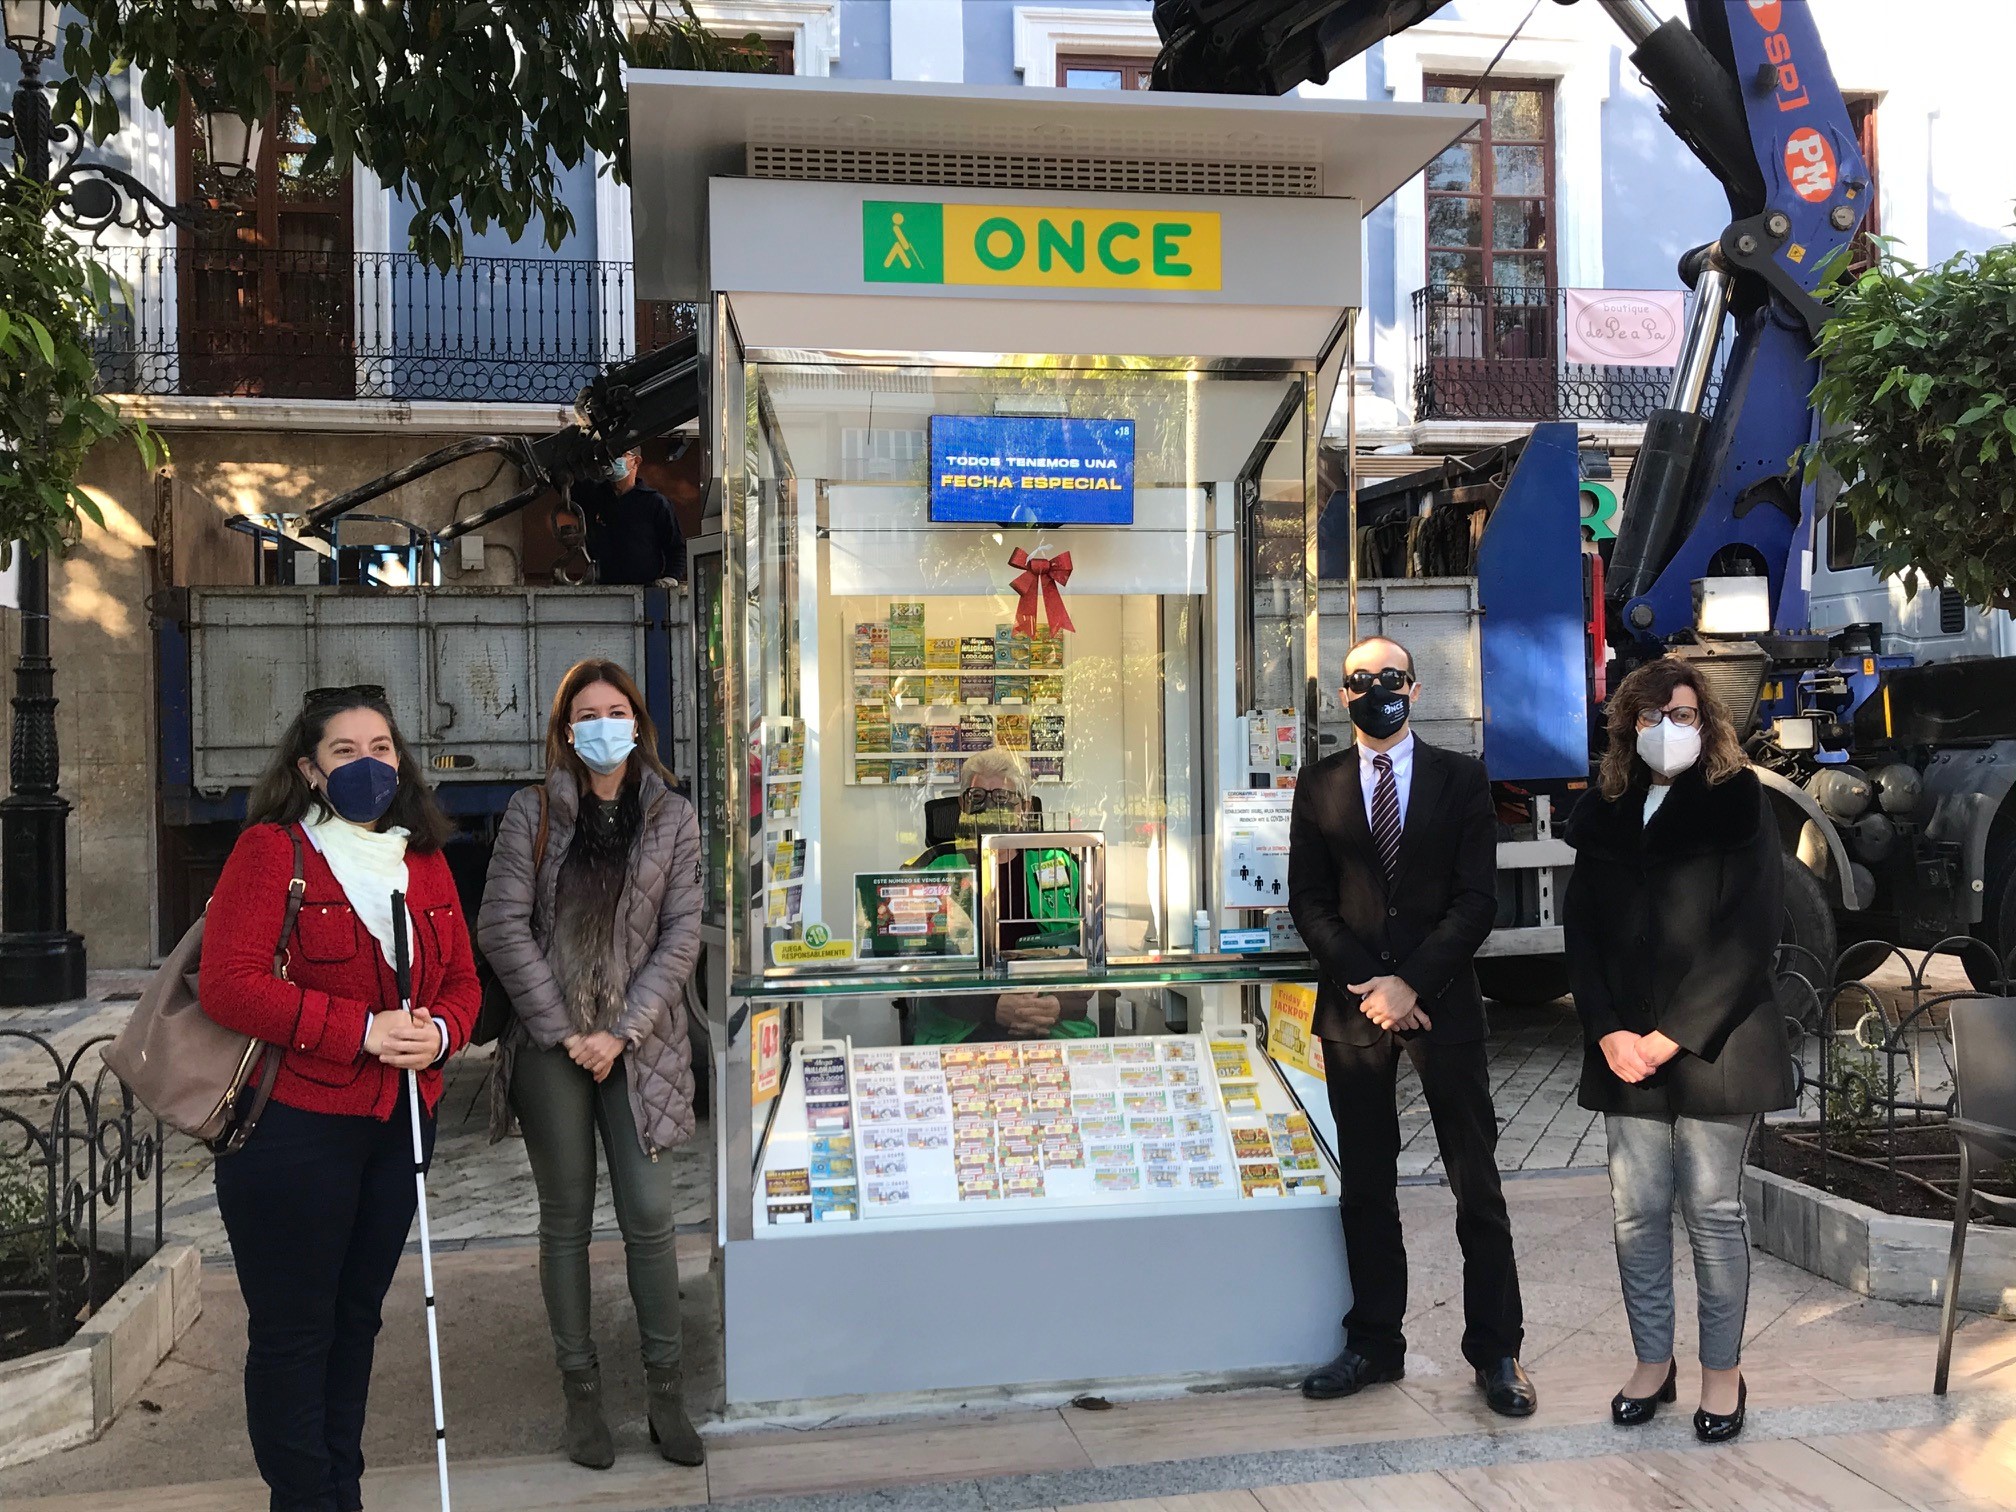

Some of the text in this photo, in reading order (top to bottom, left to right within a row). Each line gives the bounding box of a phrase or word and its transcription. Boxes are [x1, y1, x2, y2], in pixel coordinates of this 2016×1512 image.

[1787, 133, 1833, 196] PM
[974, 216, 1193, 277] ONCE
[1603, 303, 1650, 315] boutique
[1114, 426, 1130, 436] +18
[946, 456, 1118, 469] TODOS TENEMOS UNA
[940, 475, 1122, 490] FECHA ESPECIAL
[807, 927, 827, 945] +18
[782, 949, 846, 960] RESPONSABLEMENTE
[1275, 1000, 1310, 1021] JACKPOT
